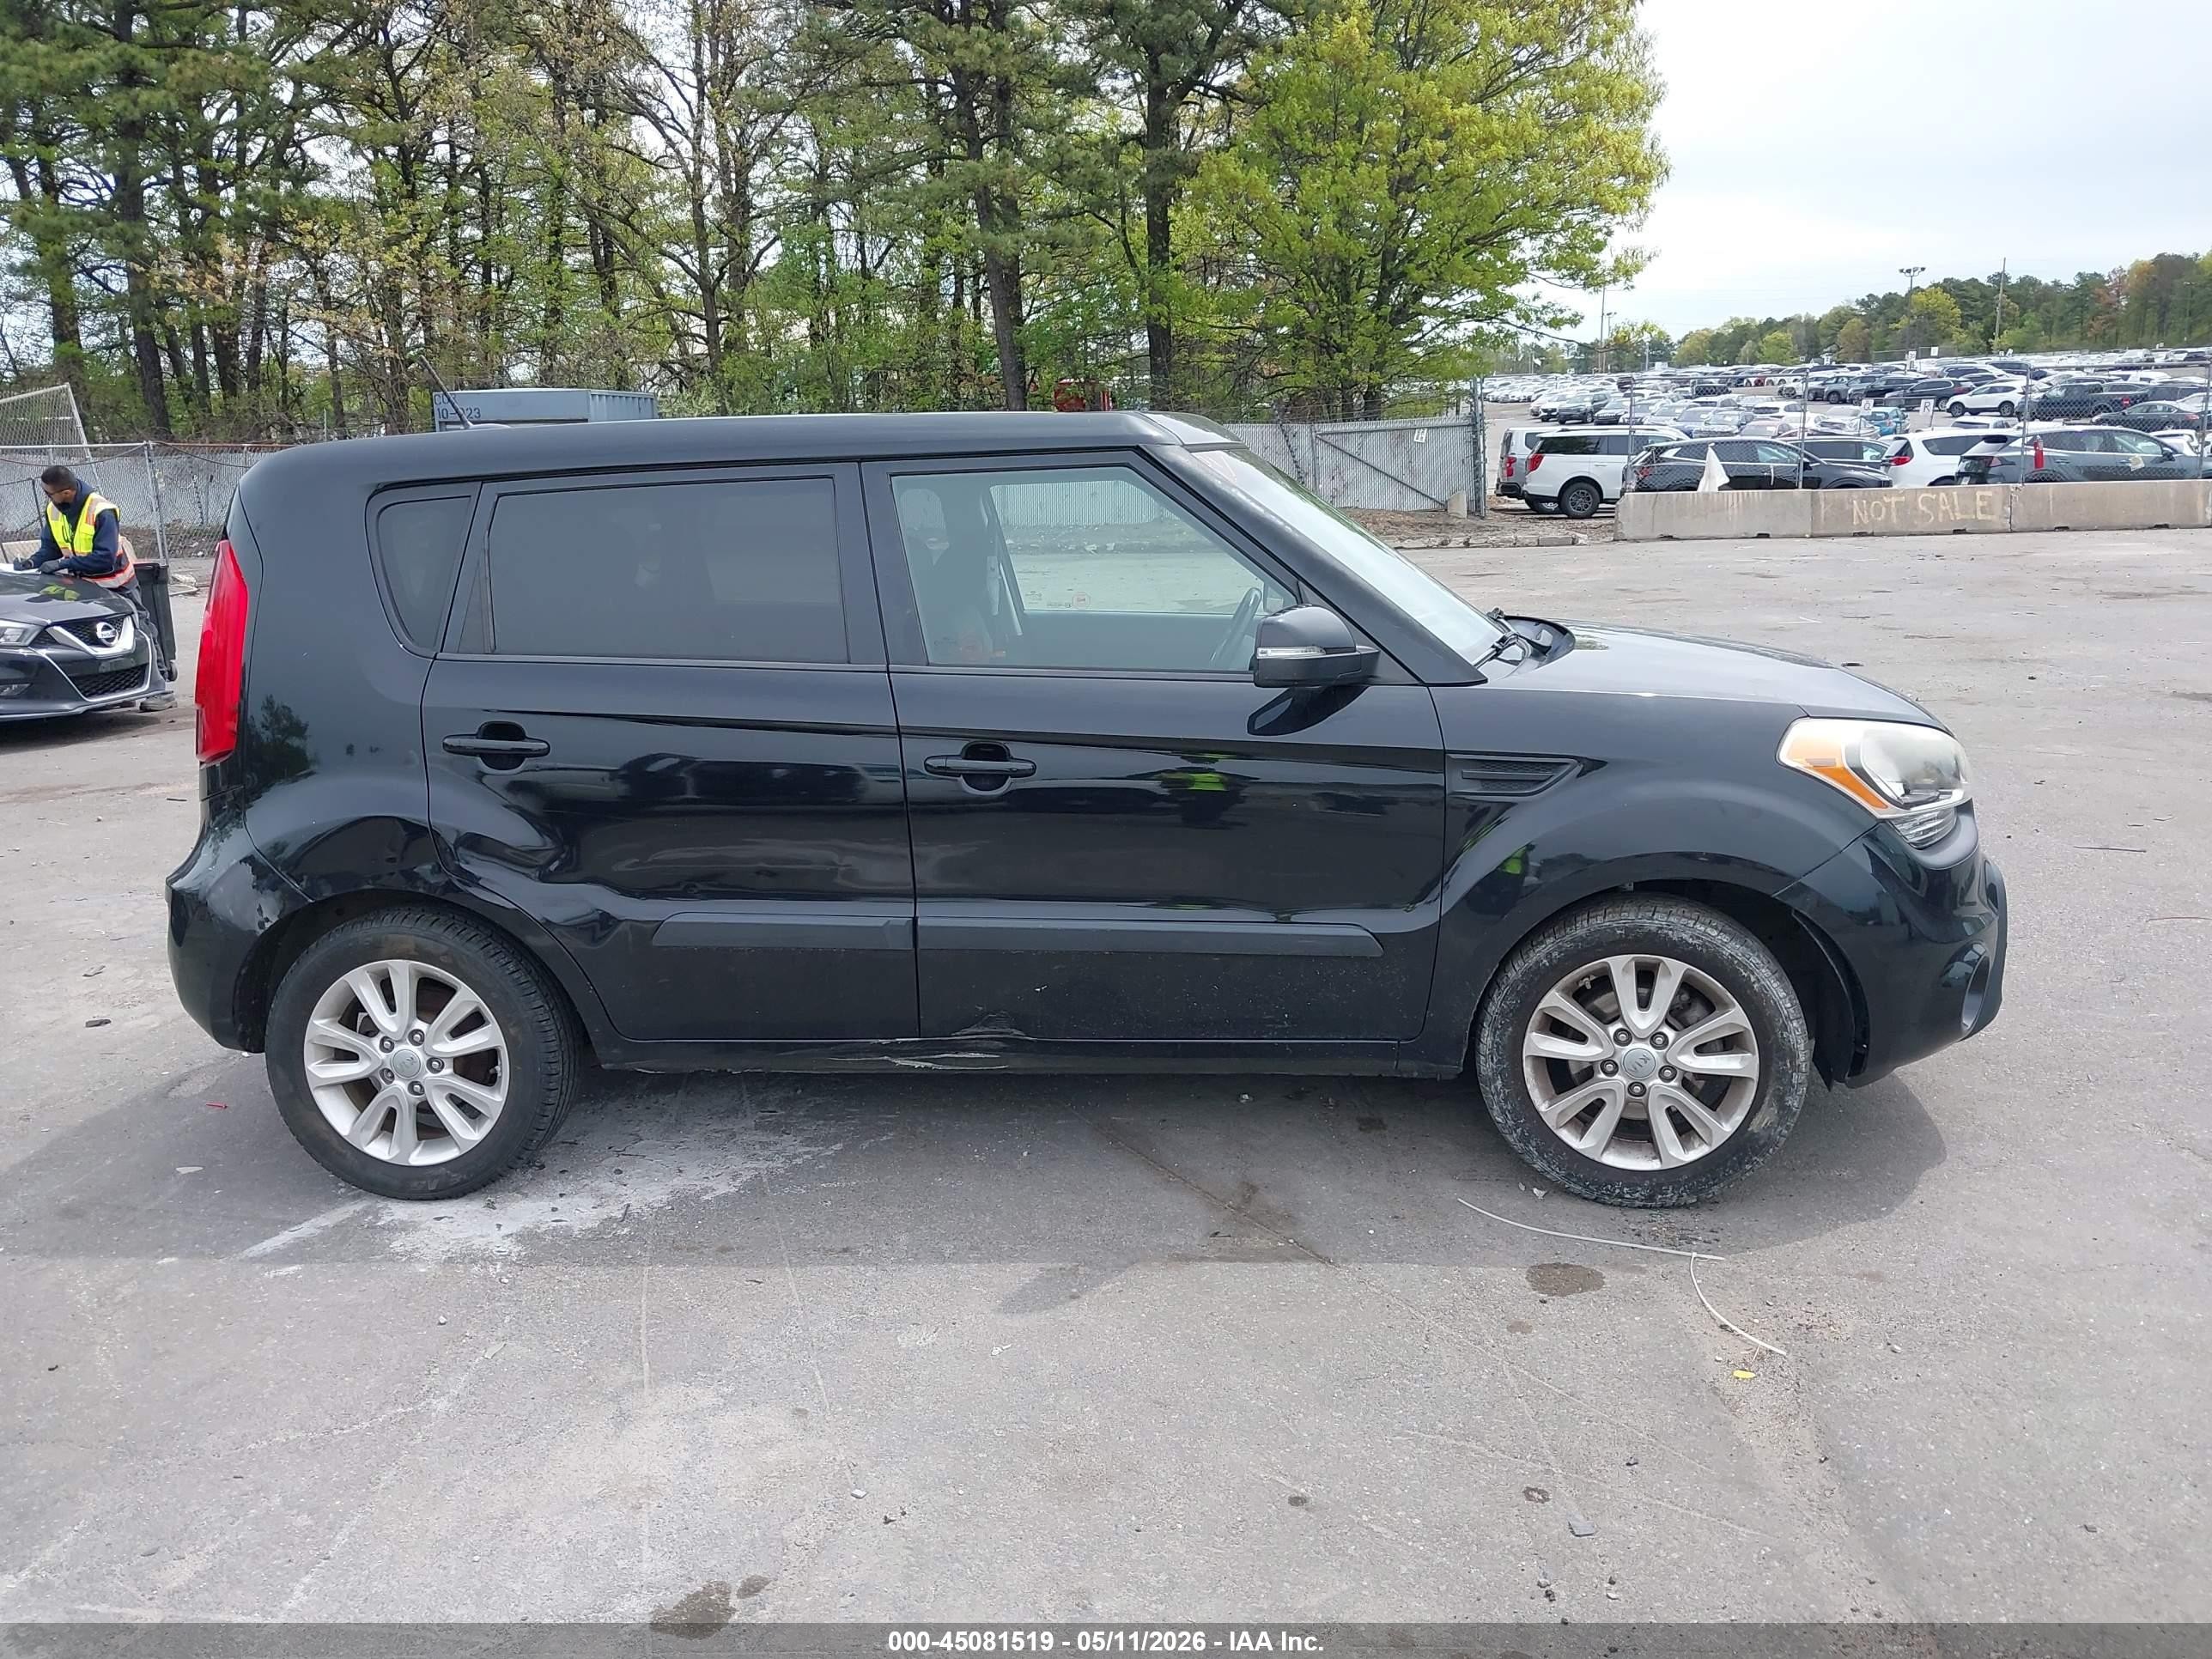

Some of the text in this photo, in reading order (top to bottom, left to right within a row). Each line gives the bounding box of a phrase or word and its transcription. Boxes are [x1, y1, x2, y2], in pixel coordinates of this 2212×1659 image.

[1923, 401, 1931, 412] R
[437, 407, 481, 419] 10-23
[1853, 491, 1993, 526] NOT SALE
